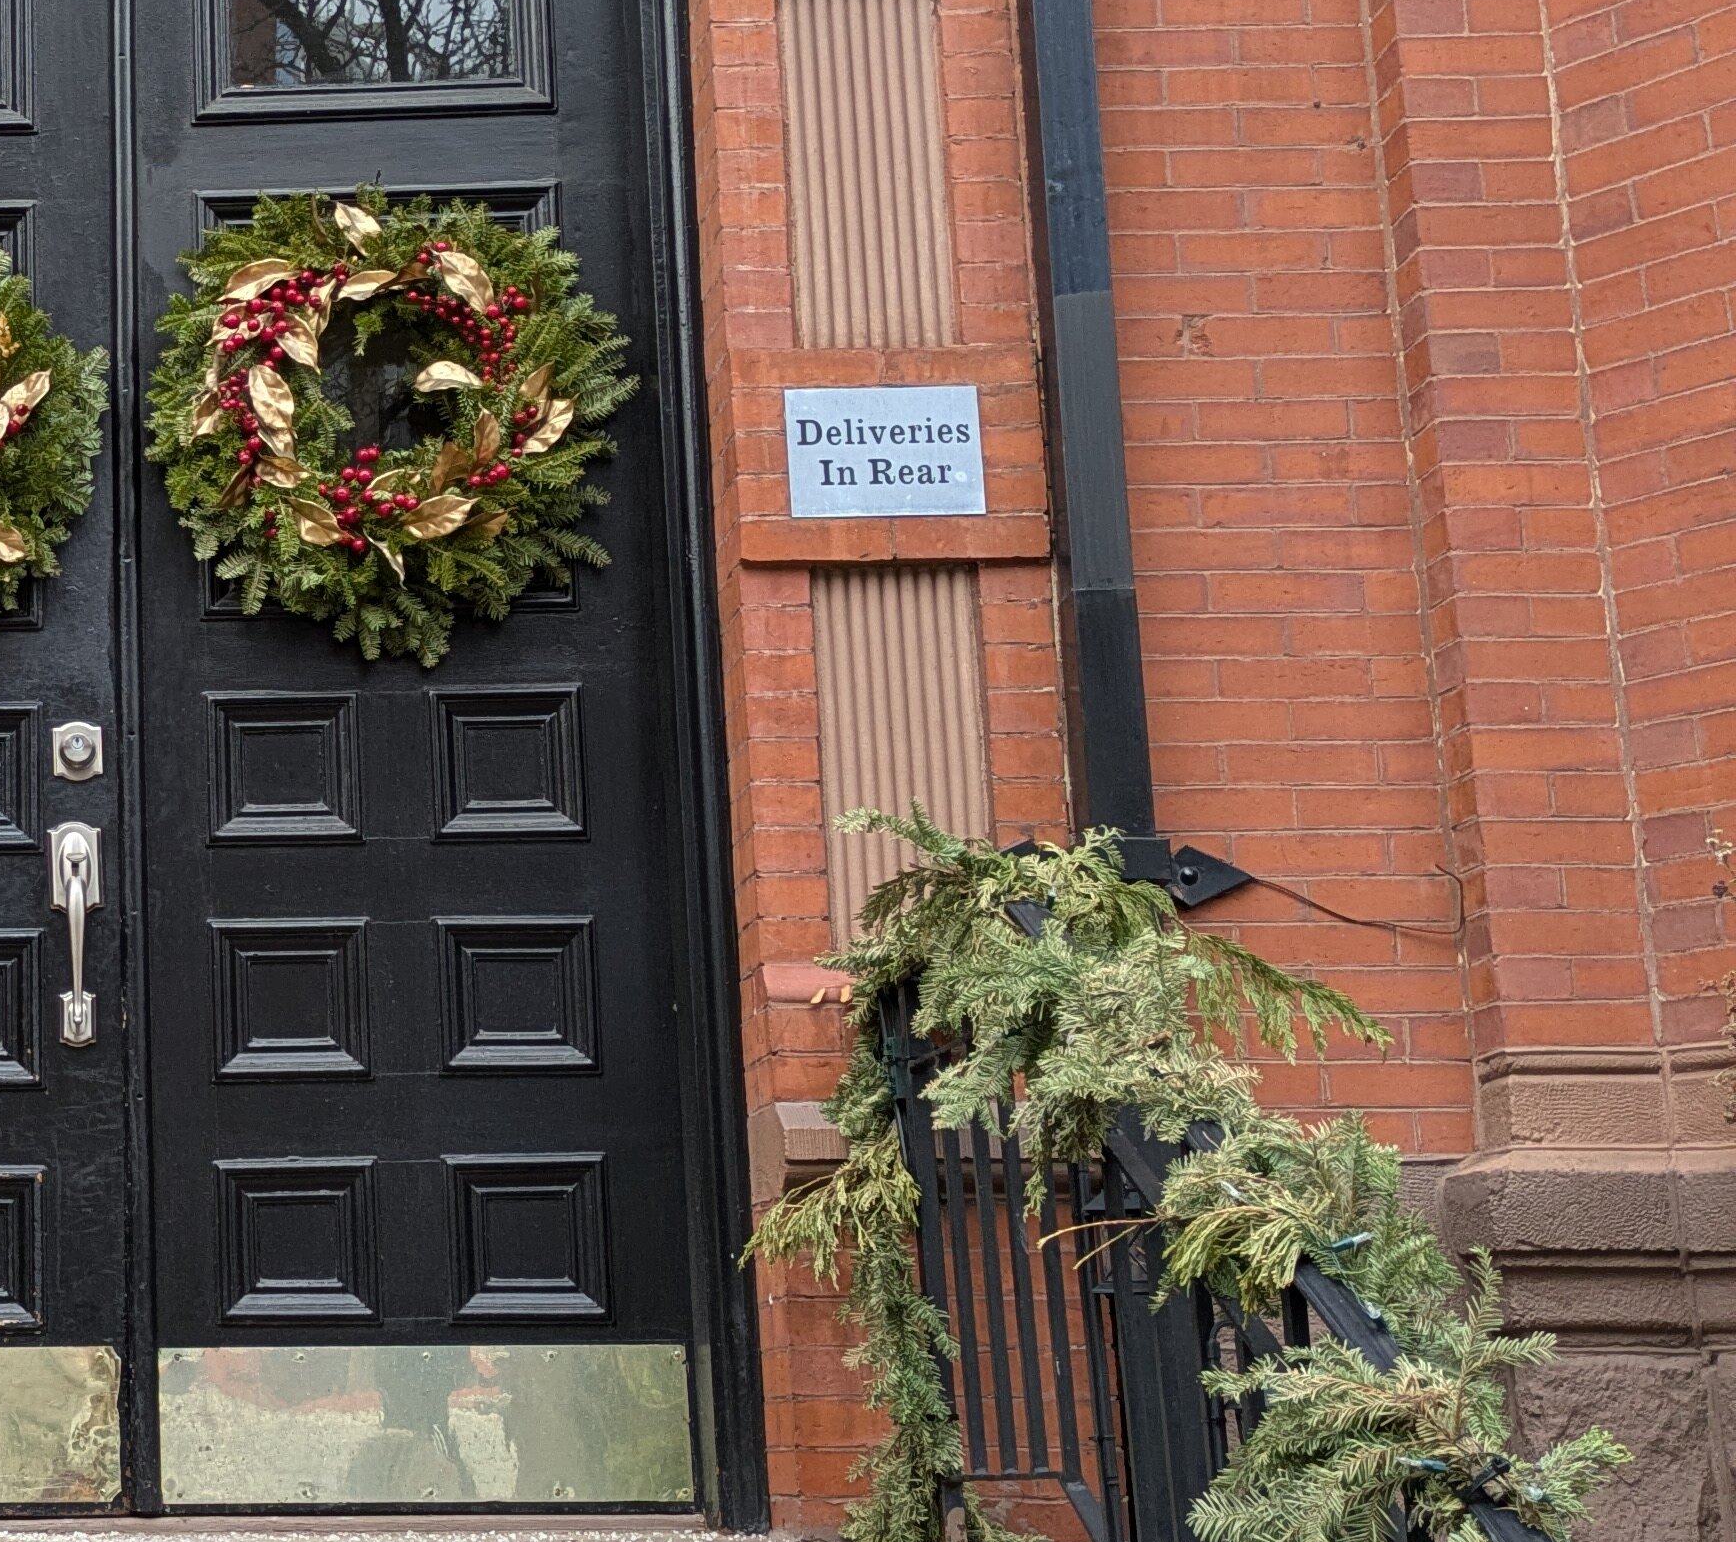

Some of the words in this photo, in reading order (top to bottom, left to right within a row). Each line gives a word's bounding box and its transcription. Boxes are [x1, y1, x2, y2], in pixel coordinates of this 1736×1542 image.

[795, 417, 971, 446] Deliveries
[818, 459, 858, 486] In
[867, 458, 952, 485] Rear
